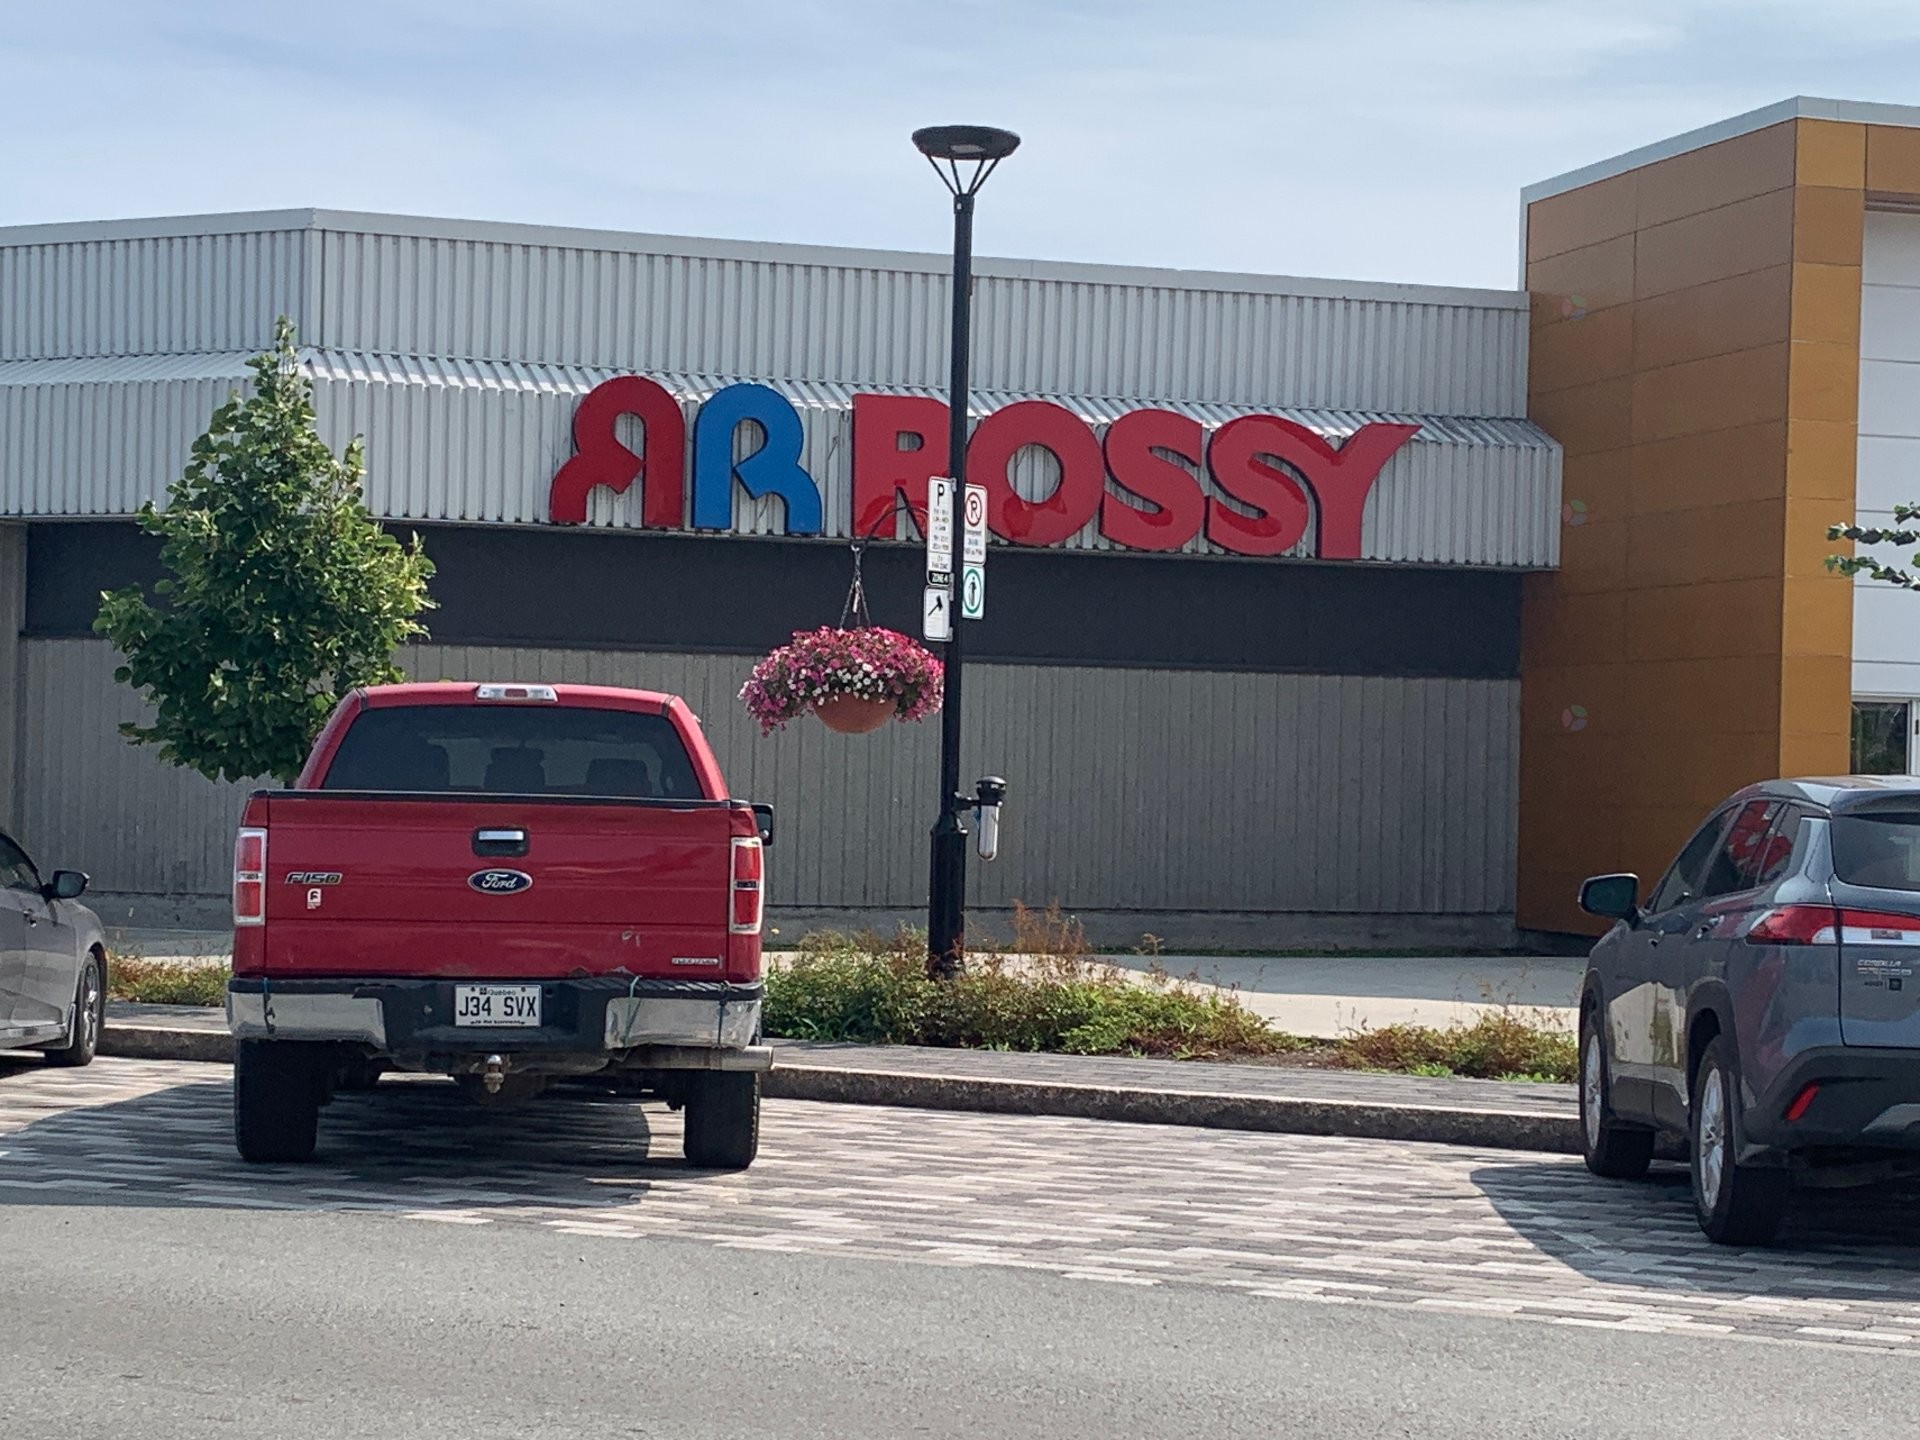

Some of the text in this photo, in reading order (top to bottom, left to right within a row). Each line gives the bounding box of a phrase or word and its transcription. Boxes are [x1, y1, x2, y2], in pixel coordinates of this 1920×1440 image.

[852, 393, 1422, 560] ROSSY
[937, 483, 945, 506] P
[481, 873, 518, 888] Ford
[459, 996, 536, 1017] J34 SVX
